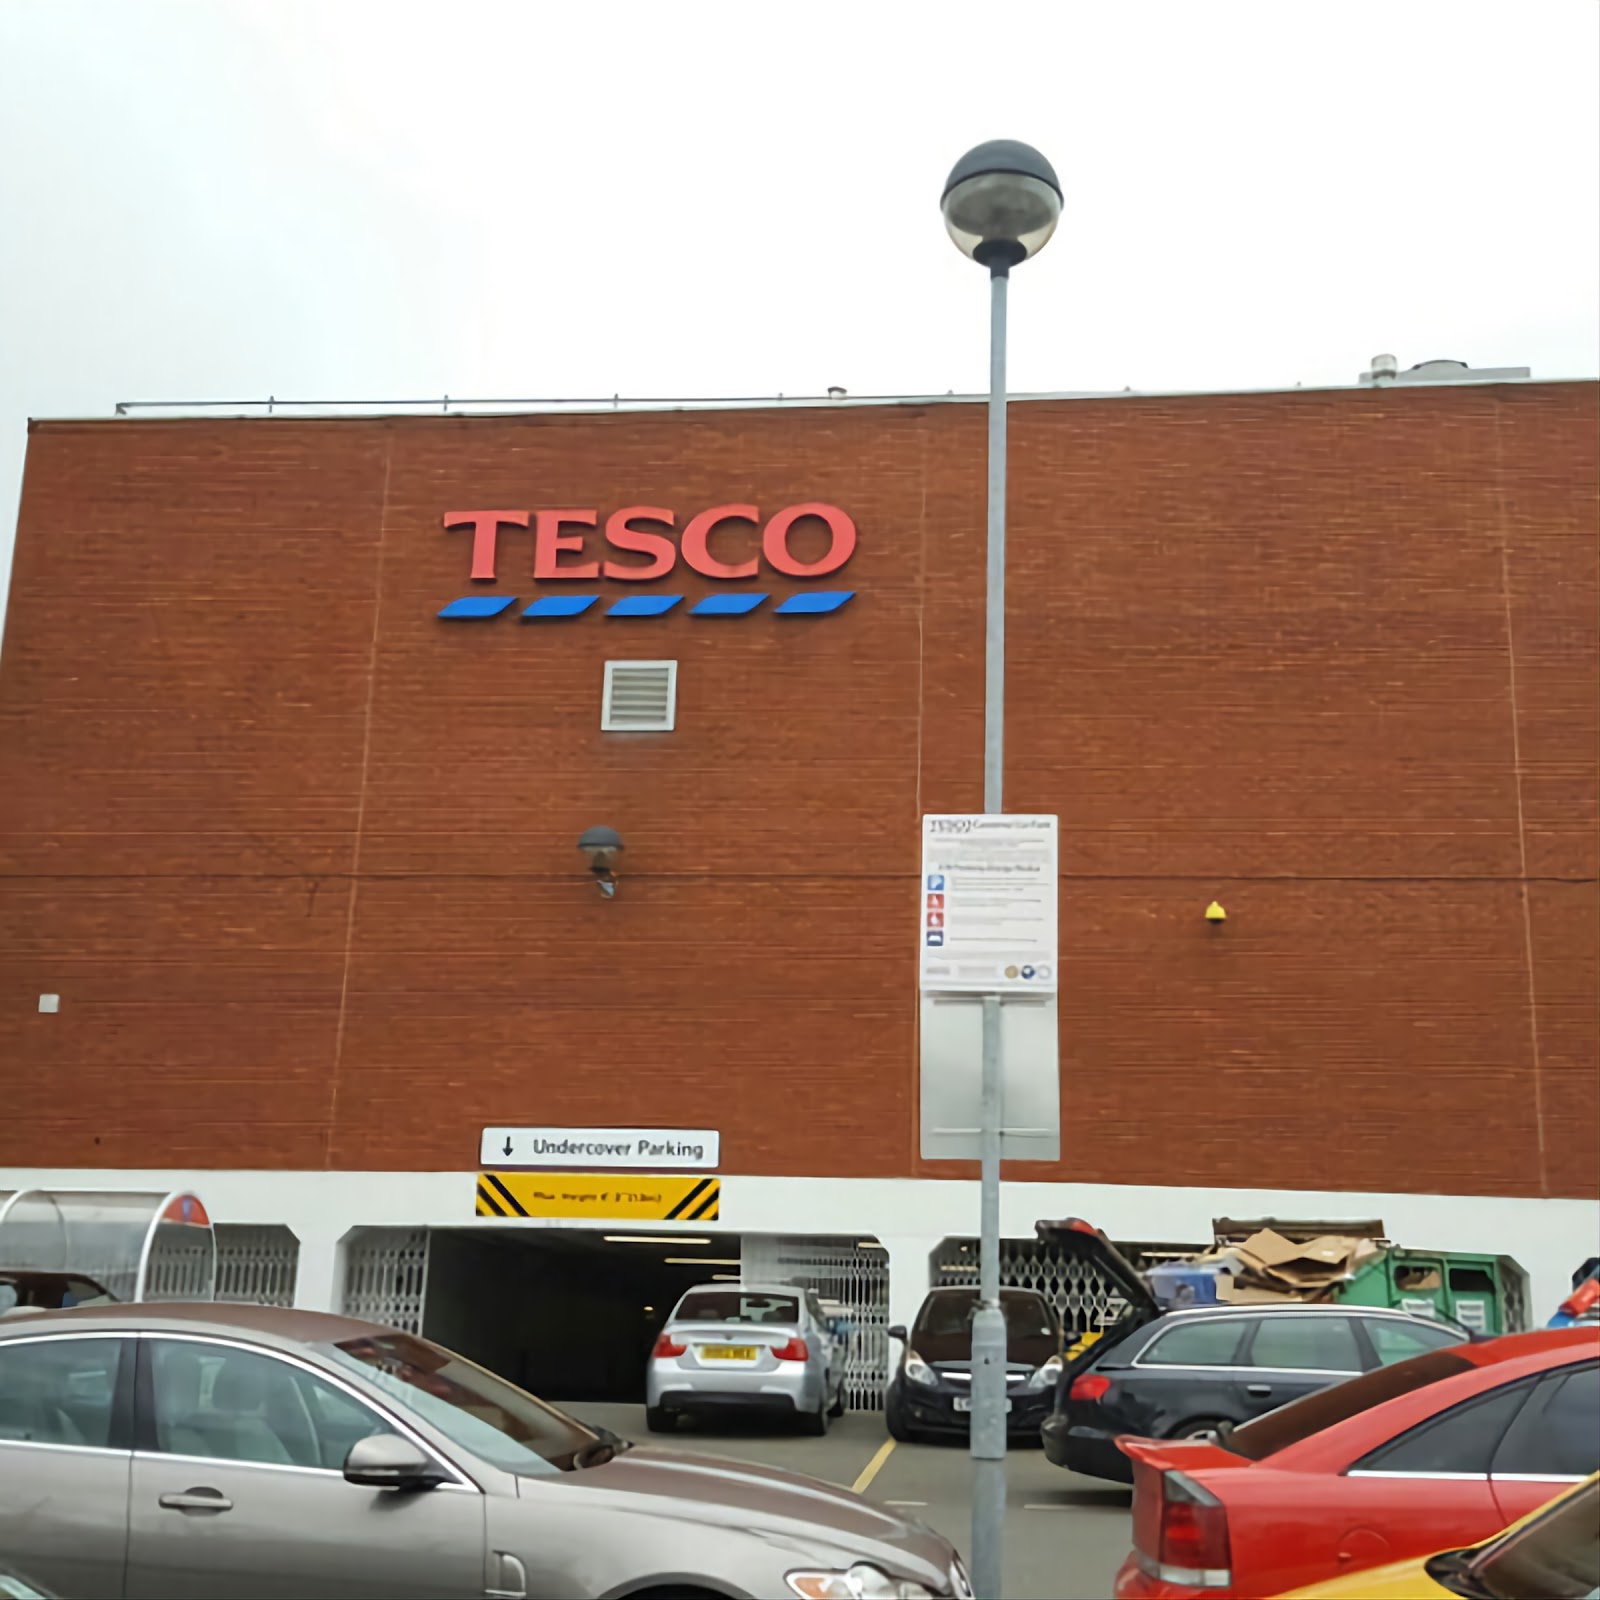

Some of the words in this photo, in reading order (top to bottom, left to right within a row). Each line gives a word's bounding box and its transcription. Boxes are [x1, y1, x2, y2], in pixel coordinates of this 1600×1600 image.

[443, 502, 857, 581] TESCO
[533, 1138, 632, 1155] Undercover
[638, 1140, 704, 1160] Parking
